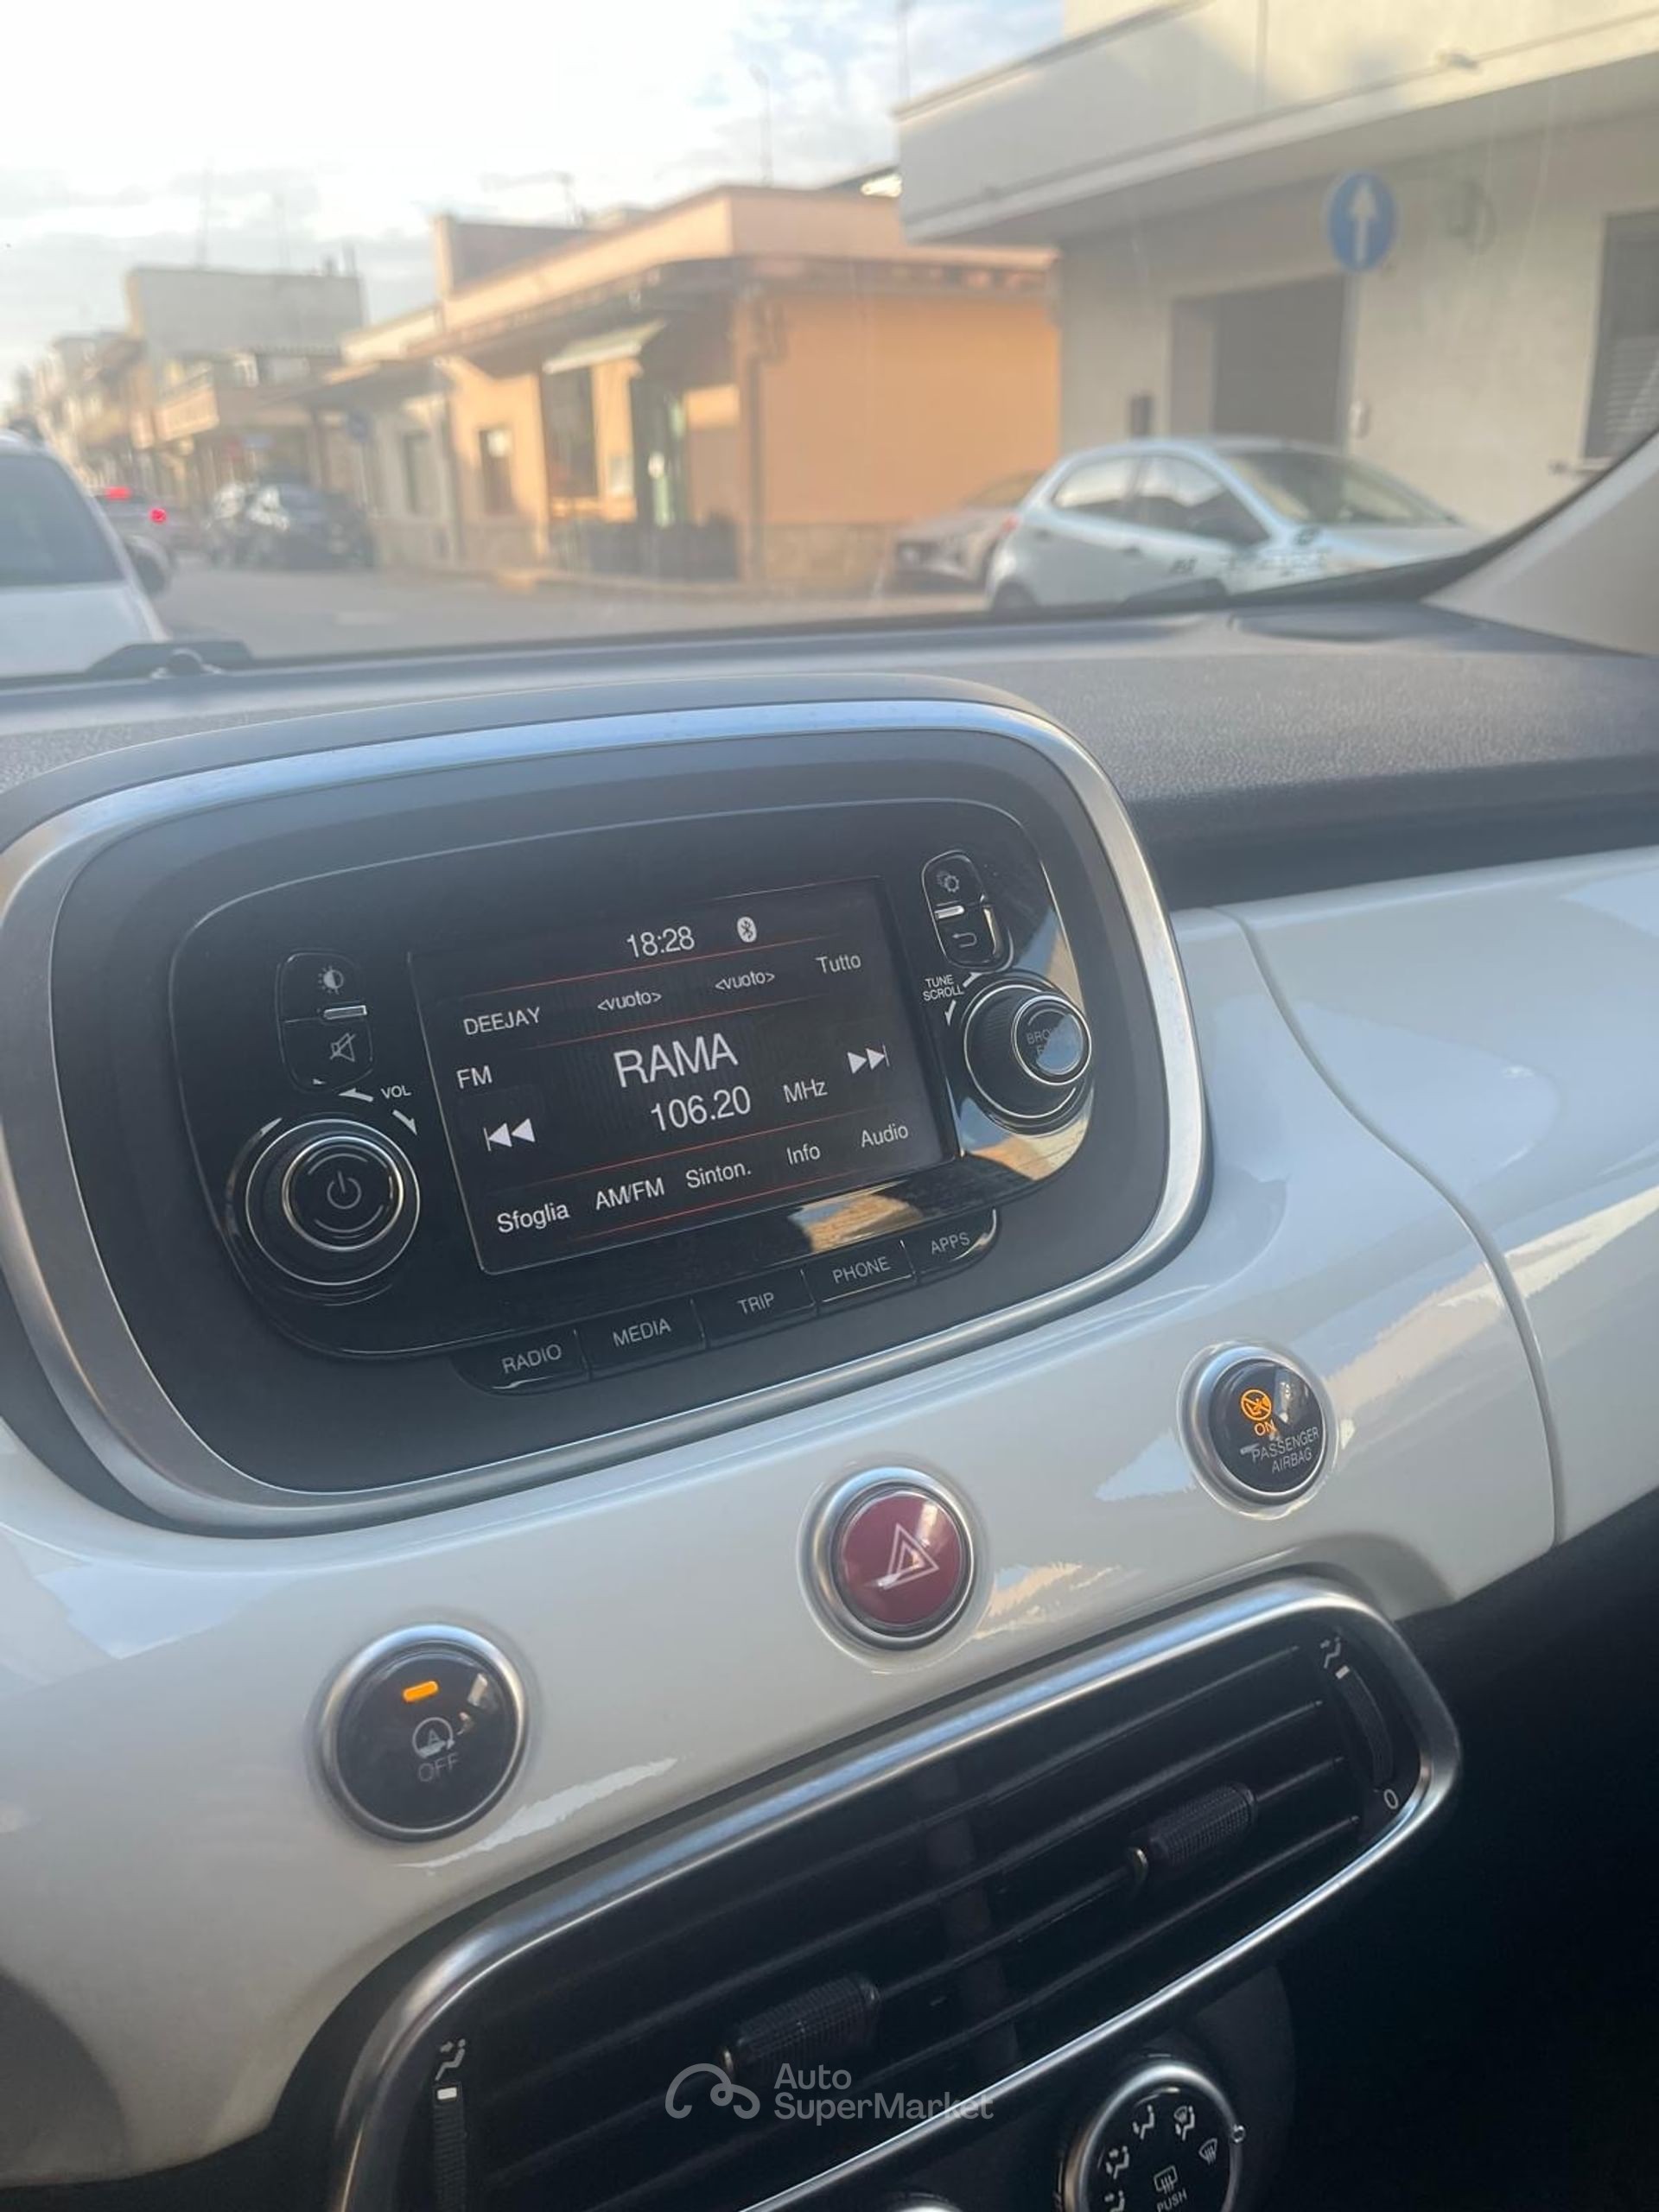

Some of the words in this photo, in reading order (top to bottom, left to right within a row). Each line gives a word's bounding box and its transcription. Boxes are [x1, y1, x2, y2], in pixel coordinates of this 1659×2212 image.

[626, 925, 696, 958] 18:28
[815, 953, 862, 974] Tutto
[715, 970, 776, 991] <vuoto>
[922, 983, 964, 1002] SCROLL
[925, 974, 956, 988] TUNE
[597, 990, 663, 1011] <vuoto>
[462, 1006, 541, 1036] DEEJAY
[613, 1032, 739, 1089] RAMA
[456, 1065, 493, 1090] FM
[380, 1084, 412, 1101] VOL
[651, 1085, 752, 1132] 106.20
[783, 1078, 829, 1103] MHz
[861, 1122, 909, 1148] Audio
[786, 1142, 821, 1166] Info
[685, 1162, 753, 1189] Sinton.
[594, 1177, 665, 1211] AM/FM
[496, 1202, 571, 1234] Sfoglia
[930, 1231, 971, 1255] APPS
[831, 1255, 892, 1285] PHONE
[737, 1291, 775, 1315] TRIP
[613, 1317, 671, 1348] MEDIA
[501, 1343, 563, 1374] RADIO
[1254, 1420, 1278, 1437] ON
[1251, 1426, 1320, 1463] PASSENGER
[1271, 1446, 1313, 1474] AIRBAG
[417, 1751, 459, 1783] OFF
[1156, 2187, 1188, 2212] PUSH
